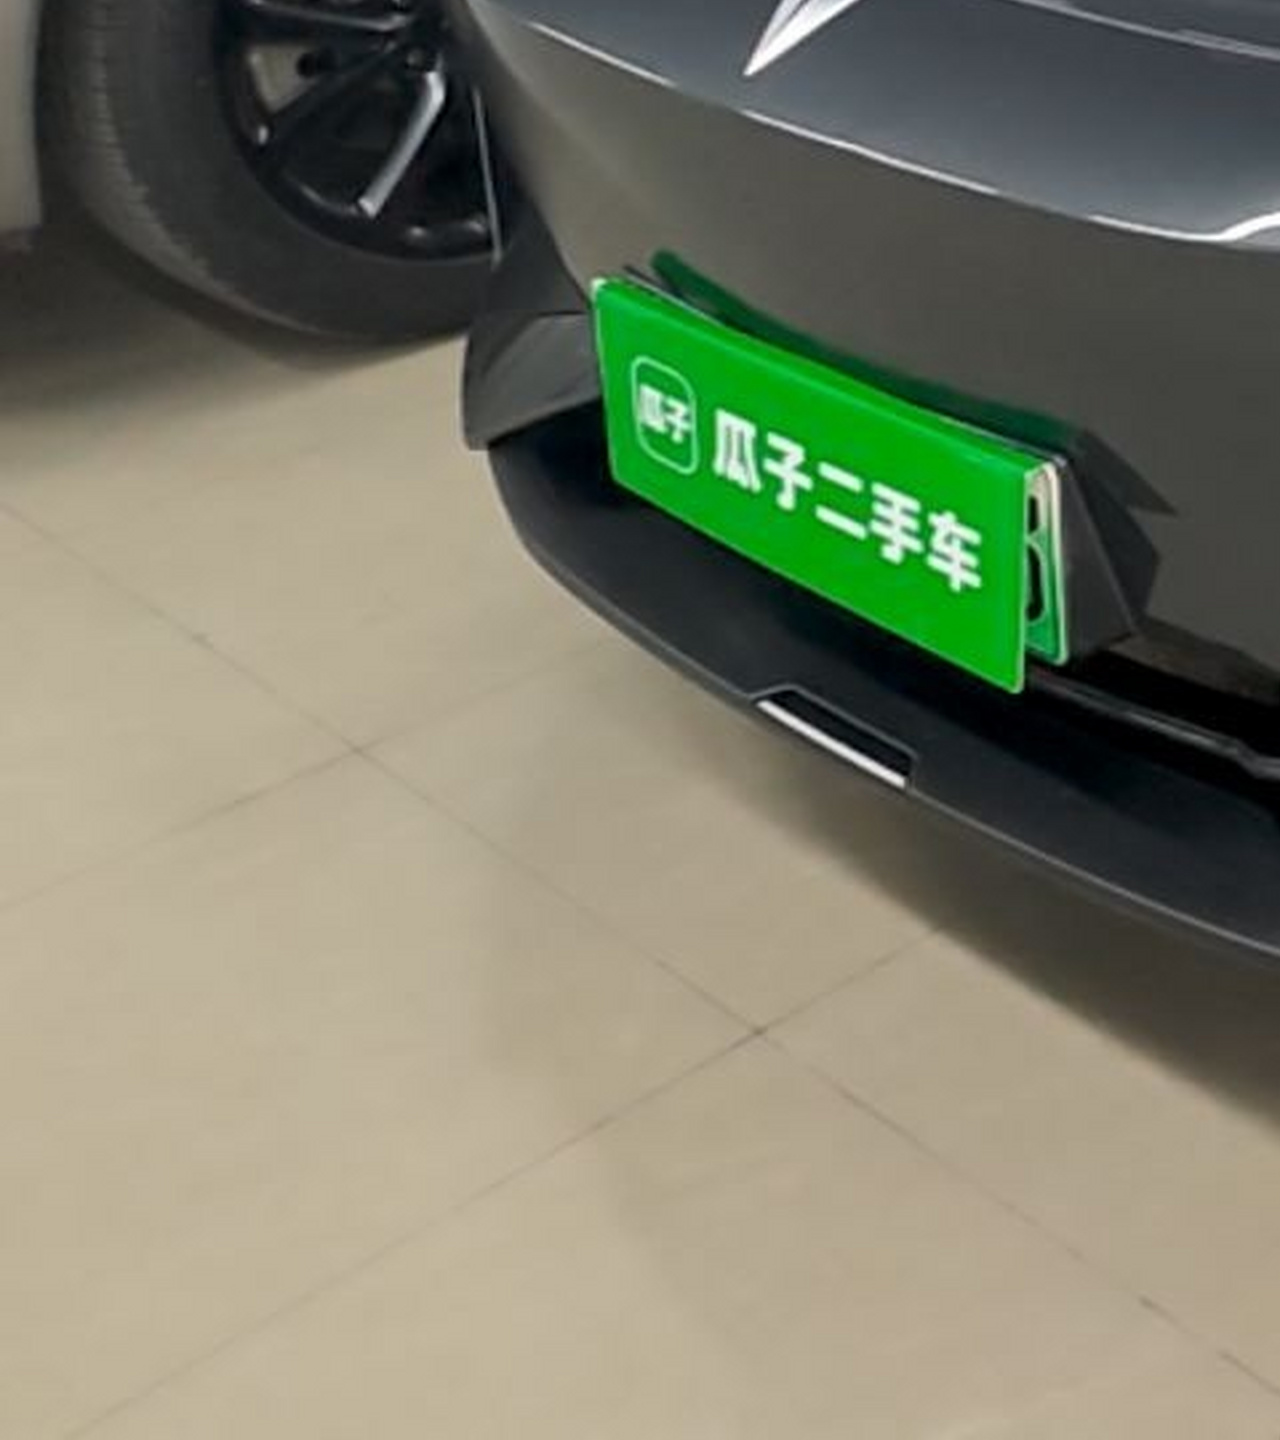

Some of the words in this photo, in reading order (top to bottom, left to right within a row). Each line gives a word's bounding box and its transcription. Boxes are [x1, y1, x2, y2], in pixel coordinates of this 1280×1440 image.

[638, 384, 692, 444] 瓜子
[712, 407, 983, 593] 瓜子二手车
